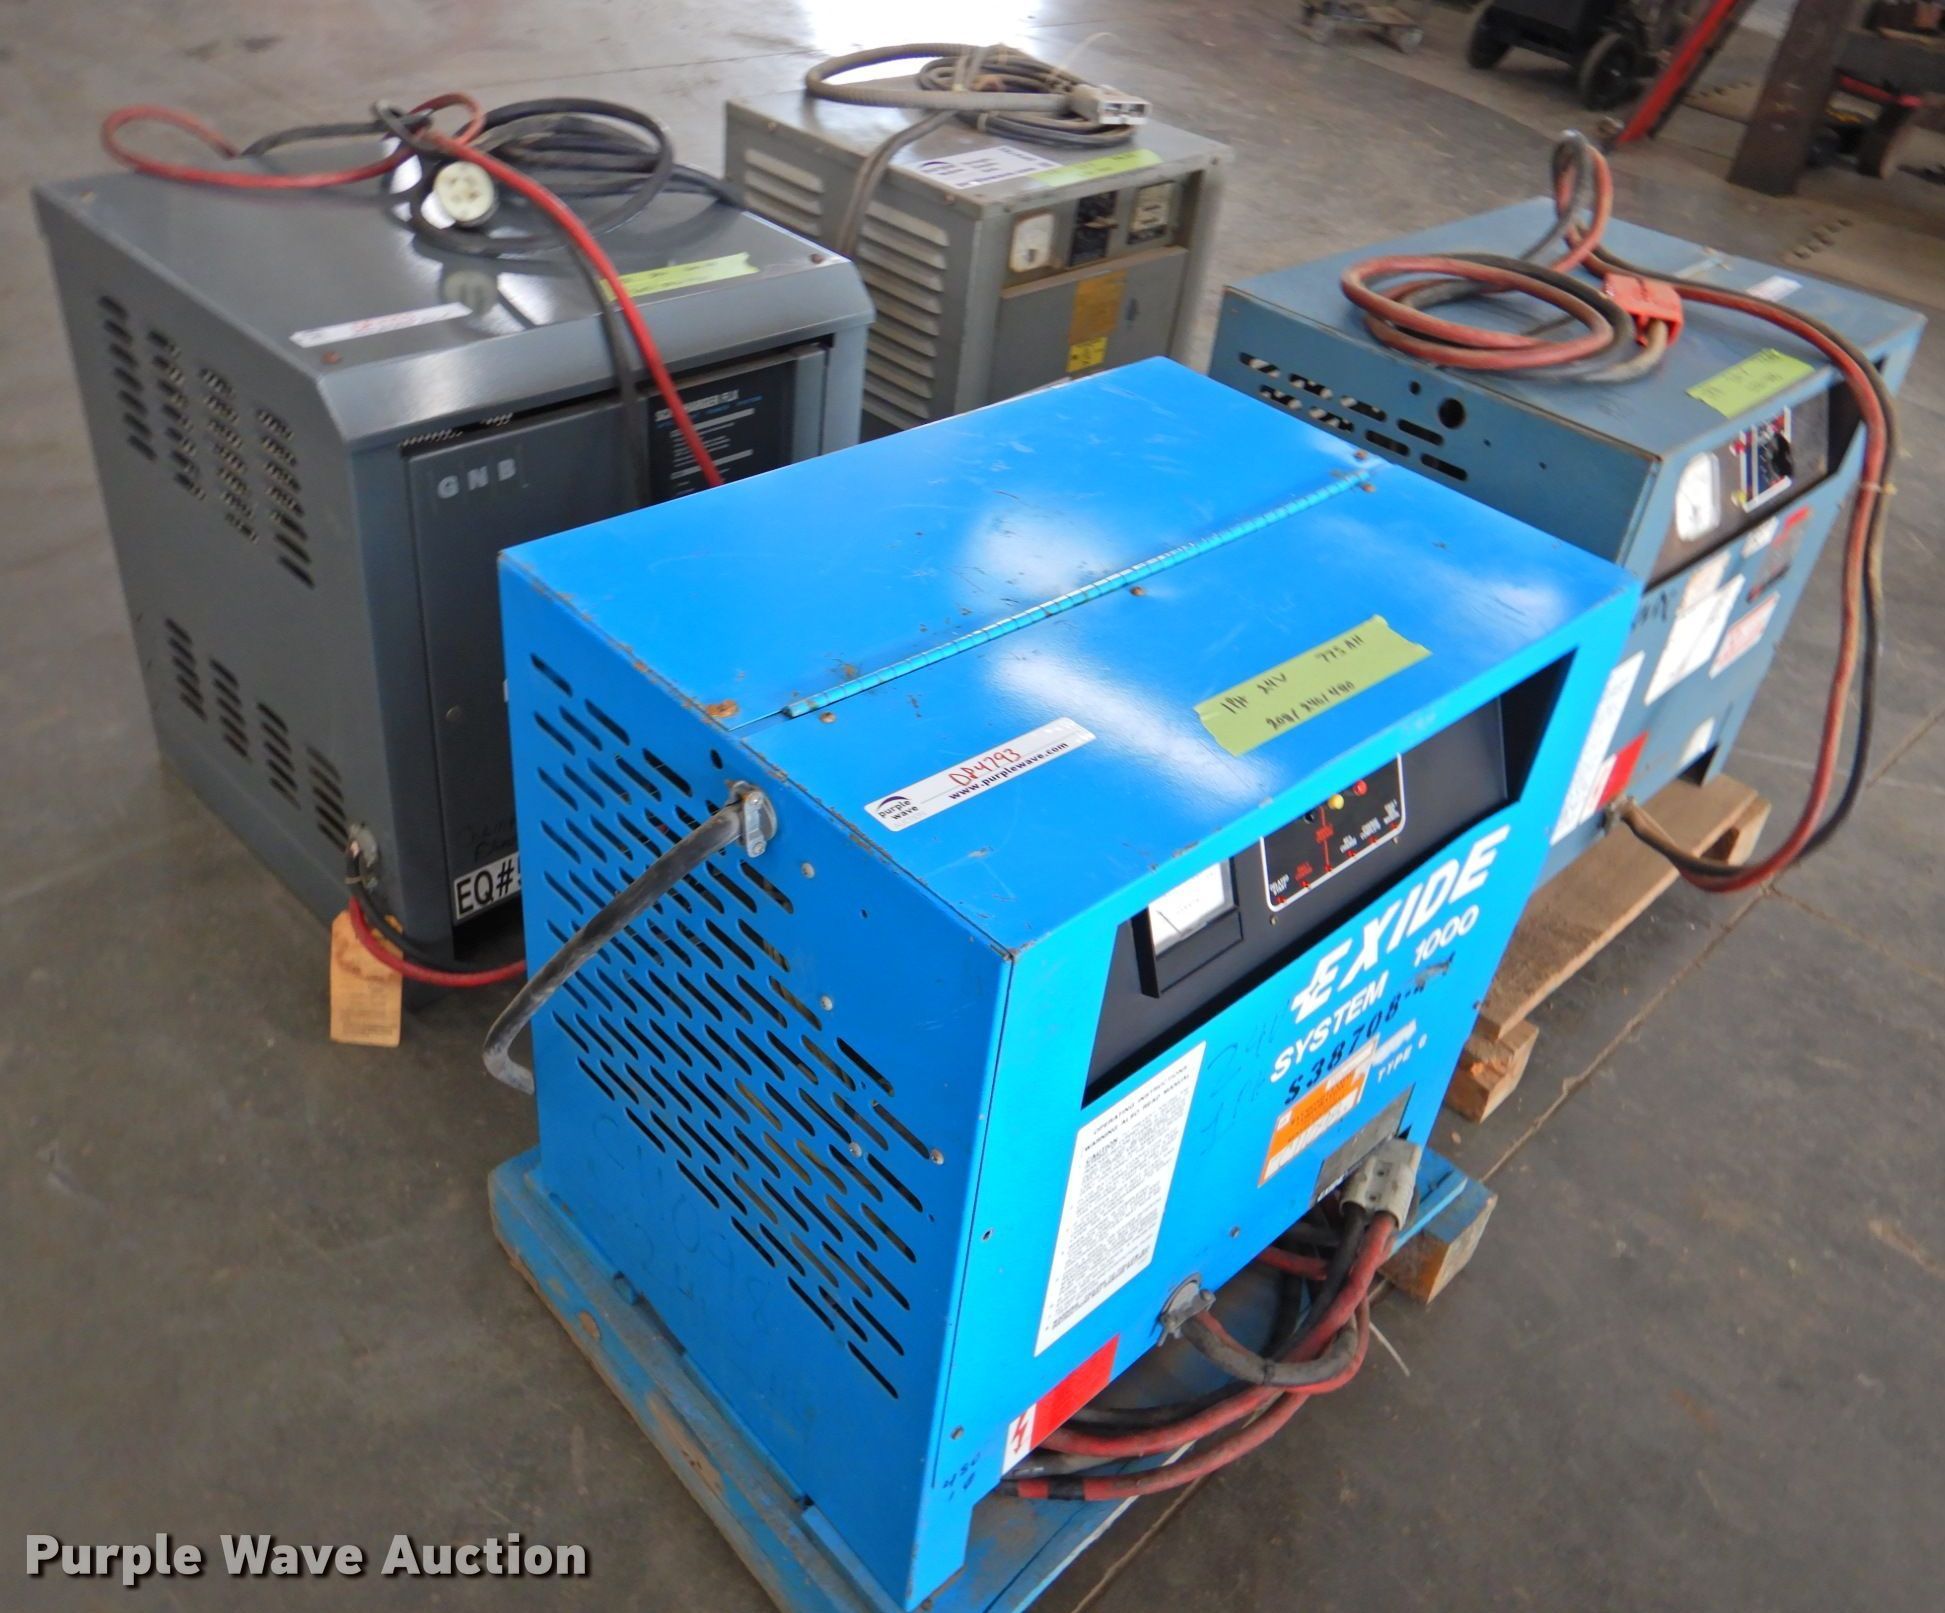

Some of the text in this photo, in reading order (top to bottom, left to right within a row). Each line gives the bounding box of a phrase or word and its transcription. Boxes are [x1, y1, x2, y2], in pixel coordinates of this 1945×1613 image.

[437, 458, 516, 499] GNB
[949, 741, 1069, 800] www.purplewave.com
[878, 798, 911, 819] purple
[891, 804, 919, 820] wave
[1290, 824, 1511, 1024] EXIDE
[1413, 904, 1479, 967] 1000
[1270, 970, 1389, 1083] SYSTEM
[1378, 1044, 1412, 1083] TYPE
